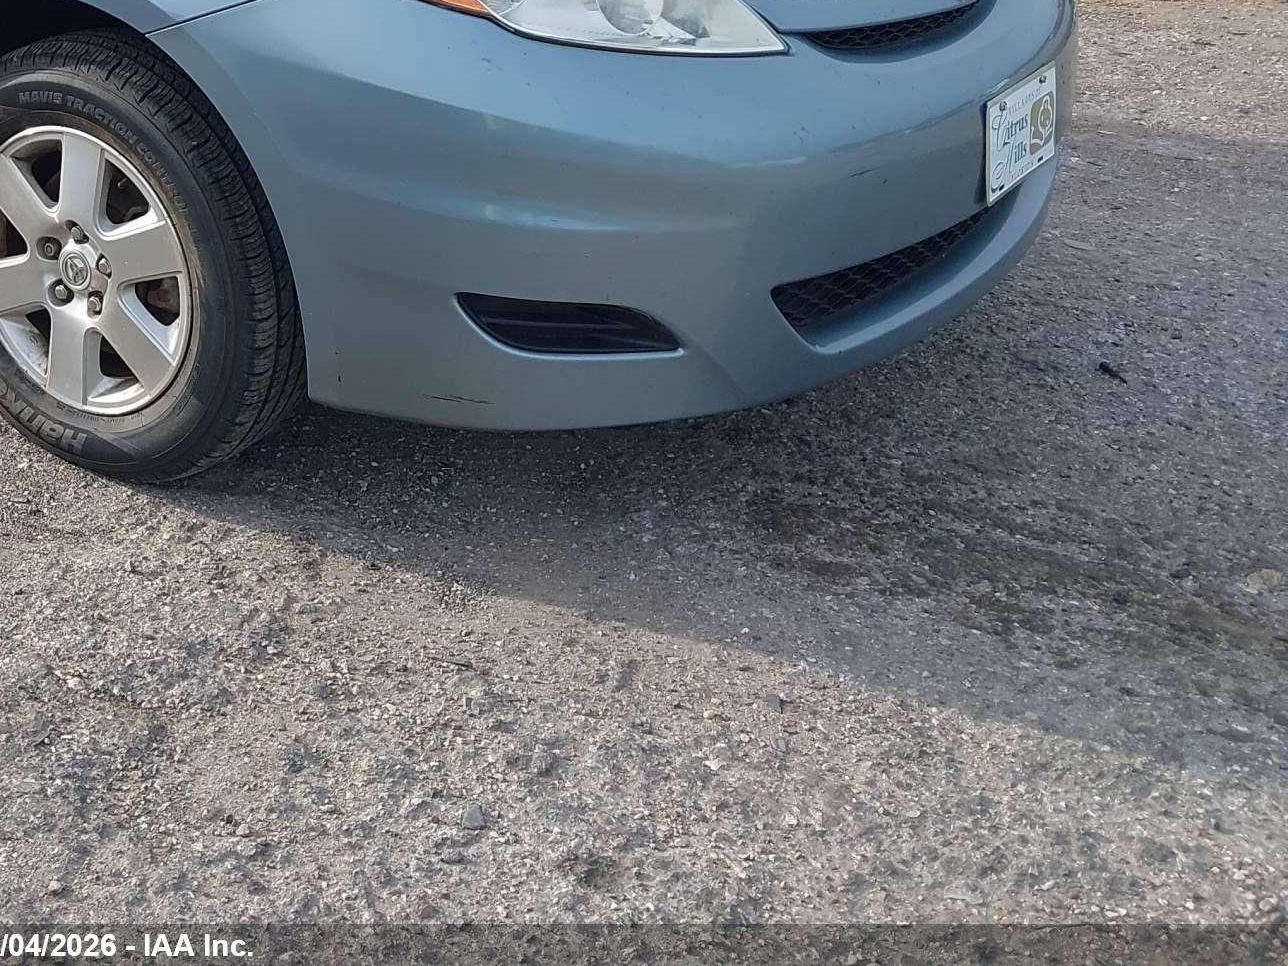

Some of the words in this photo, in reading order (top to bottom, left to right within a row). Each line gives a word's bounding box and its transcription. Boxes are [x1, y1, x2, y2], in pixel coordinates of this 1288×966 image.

[18, 90, 64, 105] MAVIS
[65, 95, 138, 144] TRACTION
[991, 110, 1029, 152] Citrus
